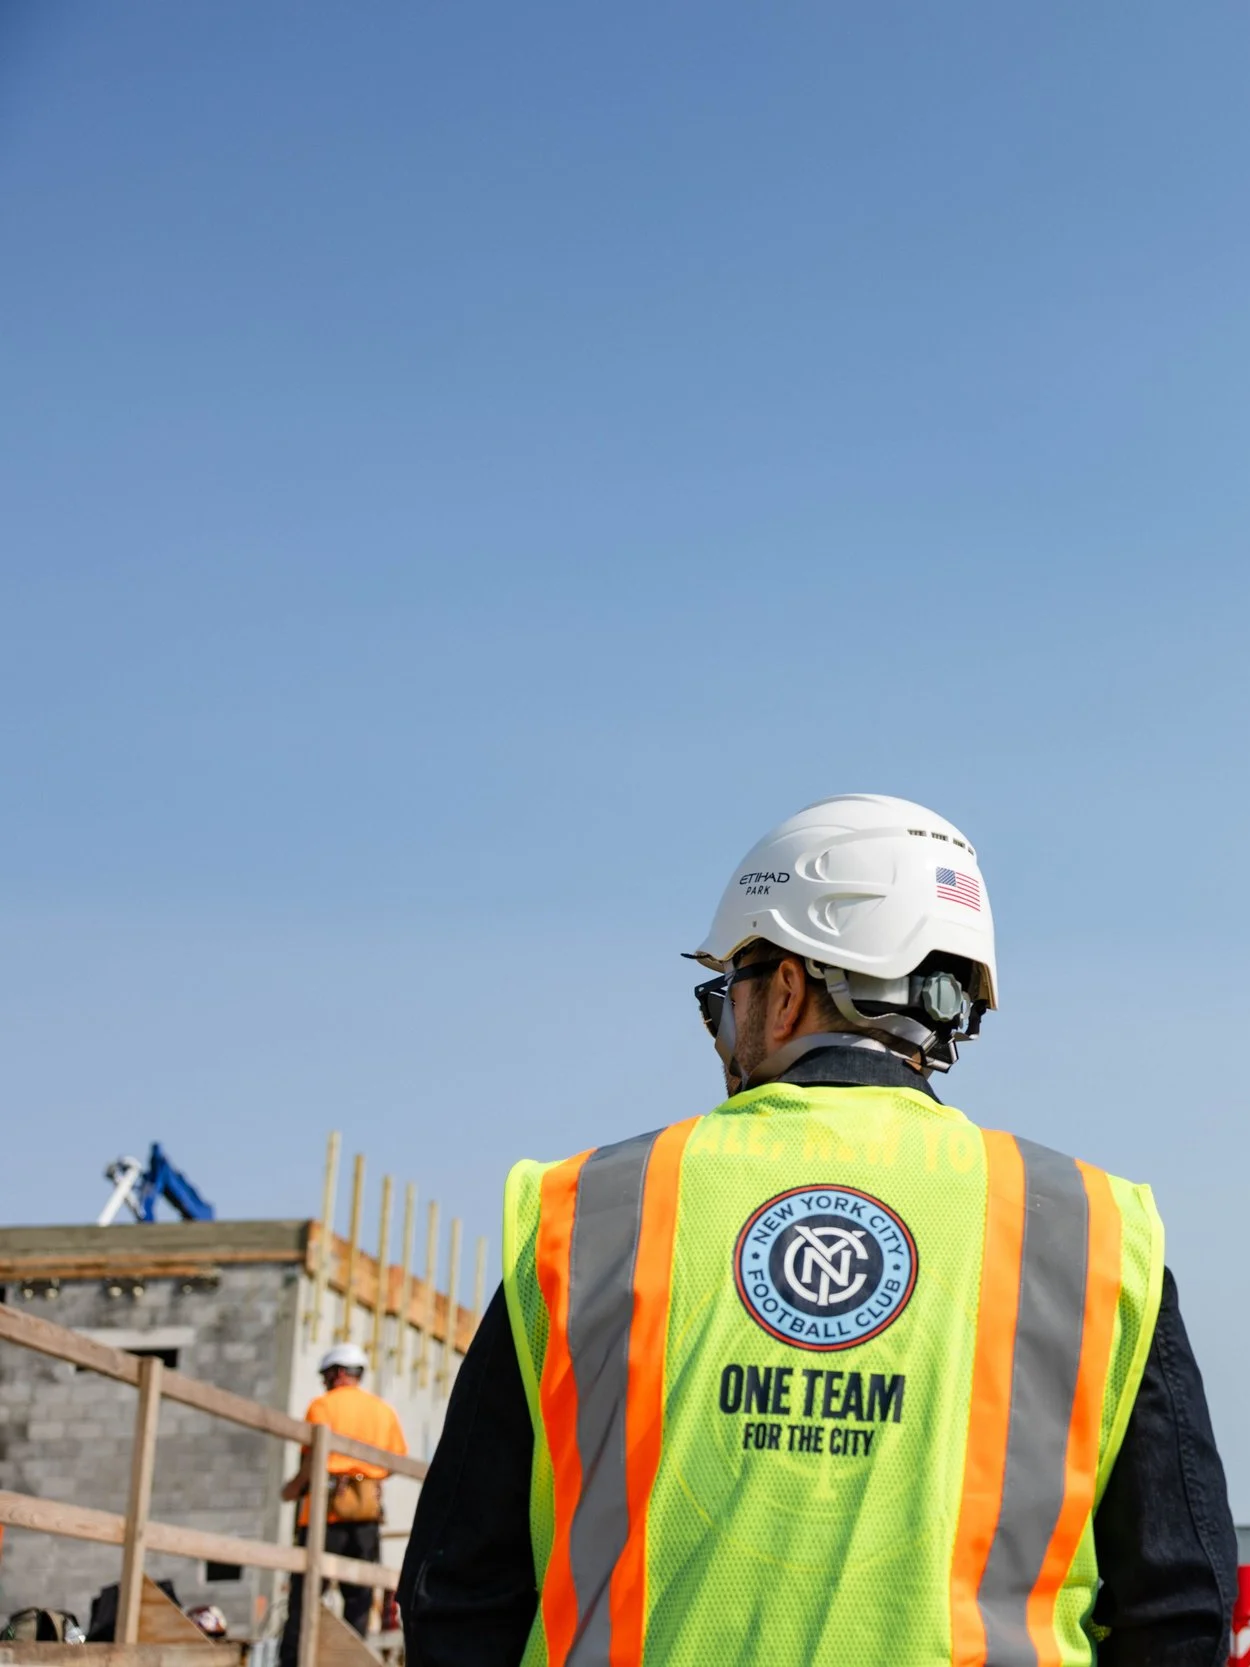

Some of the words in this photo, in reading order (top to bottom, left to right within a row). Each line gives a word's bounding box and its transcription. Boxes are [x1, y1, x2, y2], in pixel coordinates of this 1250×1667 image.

[740, 872, 790, 885] ETIHAD
[746, 885, 771, 895] PARK
[753, 1203, 794, 1245] NEW
[801, 1195, 867, 1218] YORK
[869, 1215, 904, 1256] CITY
[748, 1269, 851, 1338] FOOTBALL
[855, 1279, 902, 1328] CLUB
[719, 1363, 794, 1415] ONE
[802, 1368, 905, 1423] TEAM
[743, 1422, 782, 1450] FOR
[788, 1424, 825, 1453] THE
[830, 1427, 875, 1456] CITY
